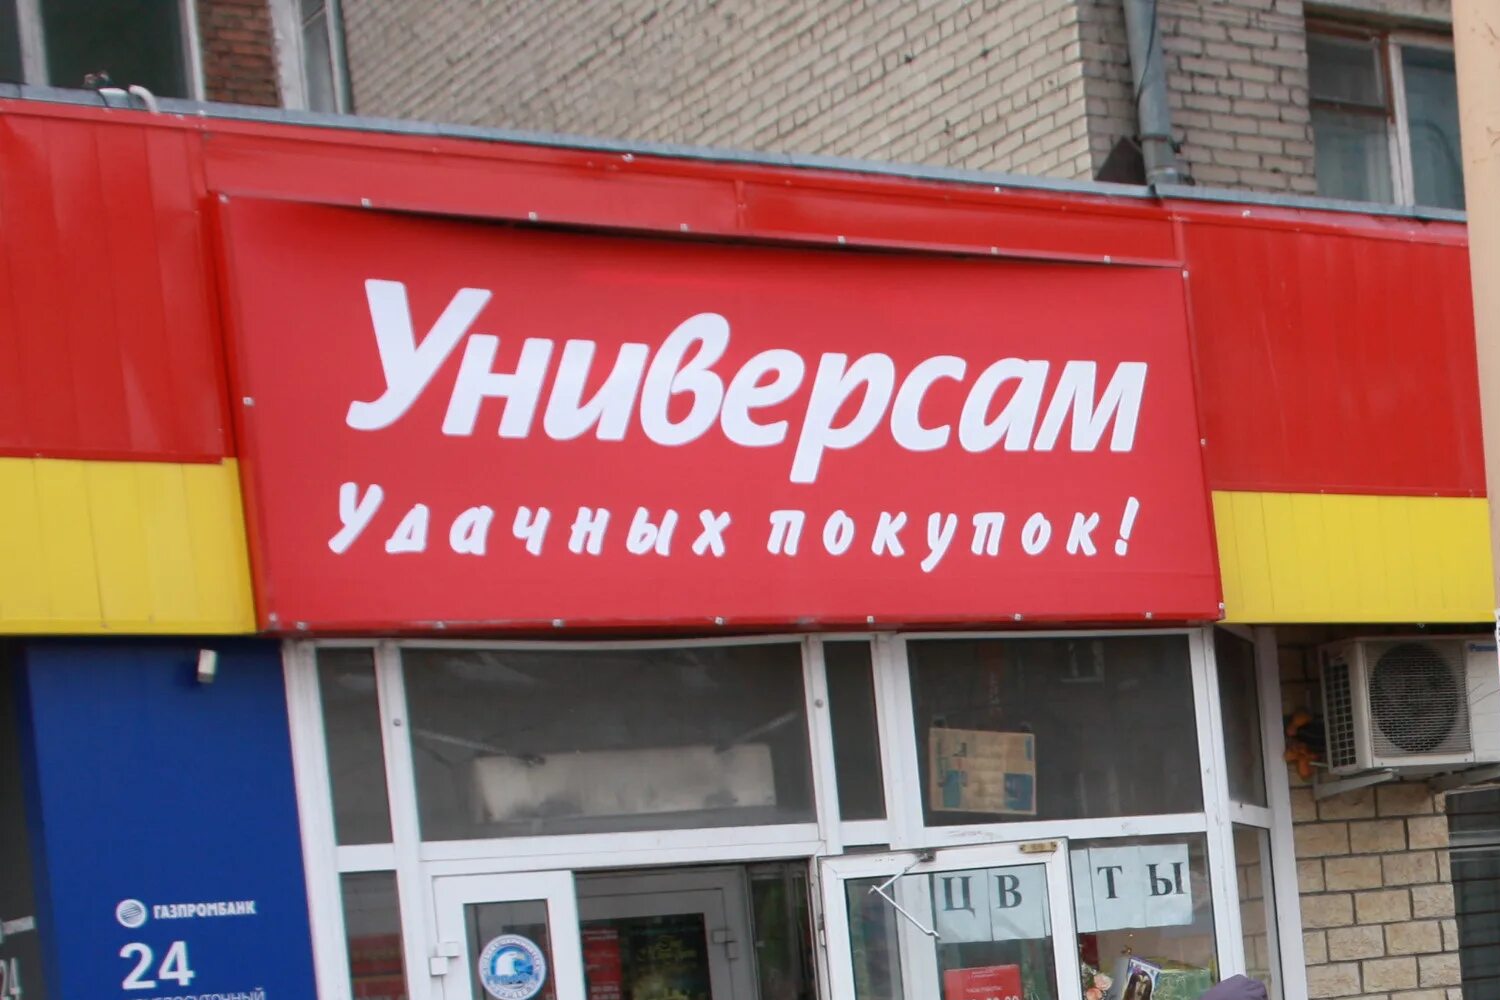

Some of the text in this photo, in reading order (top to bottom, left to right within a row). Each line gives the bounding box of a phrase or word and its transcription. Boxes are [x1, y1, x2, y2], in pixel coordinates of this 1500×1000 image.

[345, 279, 1148, 484] Универсам
[327, 481, 1141, 573] Удачных покупок!
[153, 900, 257, 920] ГАЗПРОМБАНК
[119, 940, 195, 991] 24
